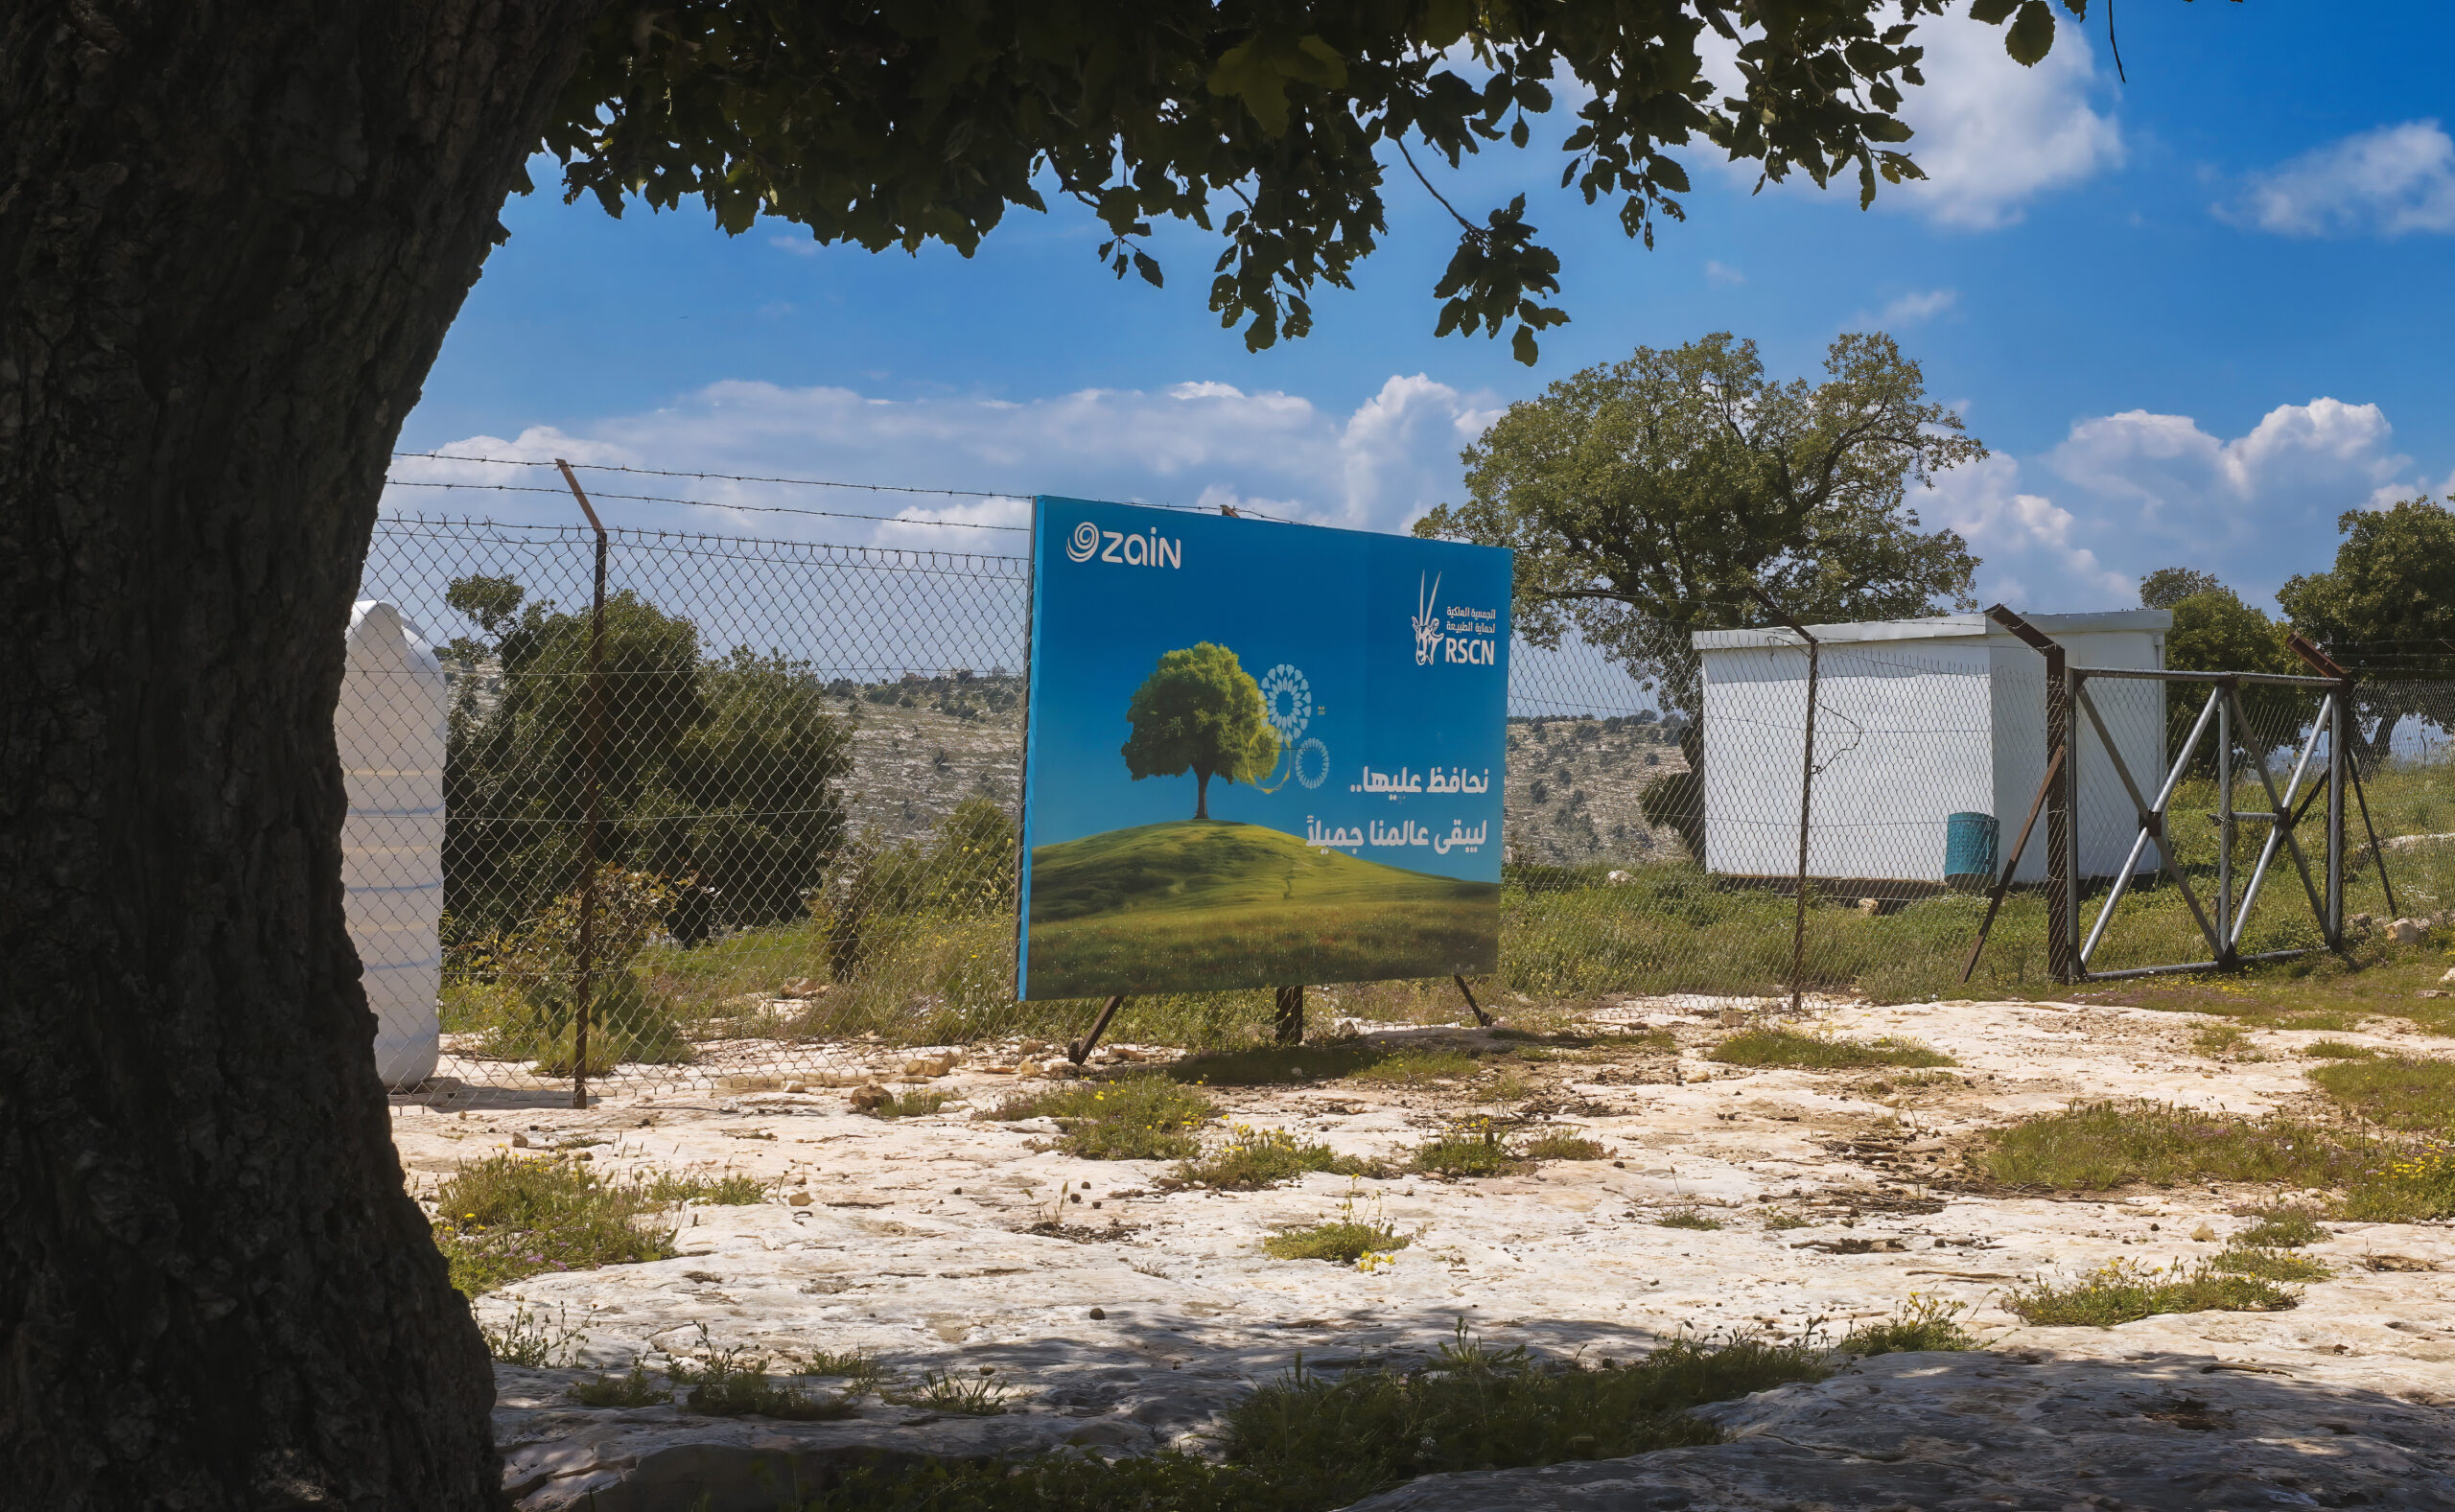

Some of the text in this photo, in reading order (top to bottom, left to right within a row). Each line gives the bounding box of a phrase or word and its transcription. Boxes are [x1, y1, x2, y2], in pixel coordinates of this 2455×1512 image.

[1446, 606, 1470, 618] الملكية
[1446, 620, 1496, 635] لحماية الطبيعة
[1445, 638, 1495, 665] RSCN
[1426, 766, 1489, 794] نحافظ
[1369, 820, 1430, 847] عالمنا
[1434, 819, 1487, 854] ليبقى
